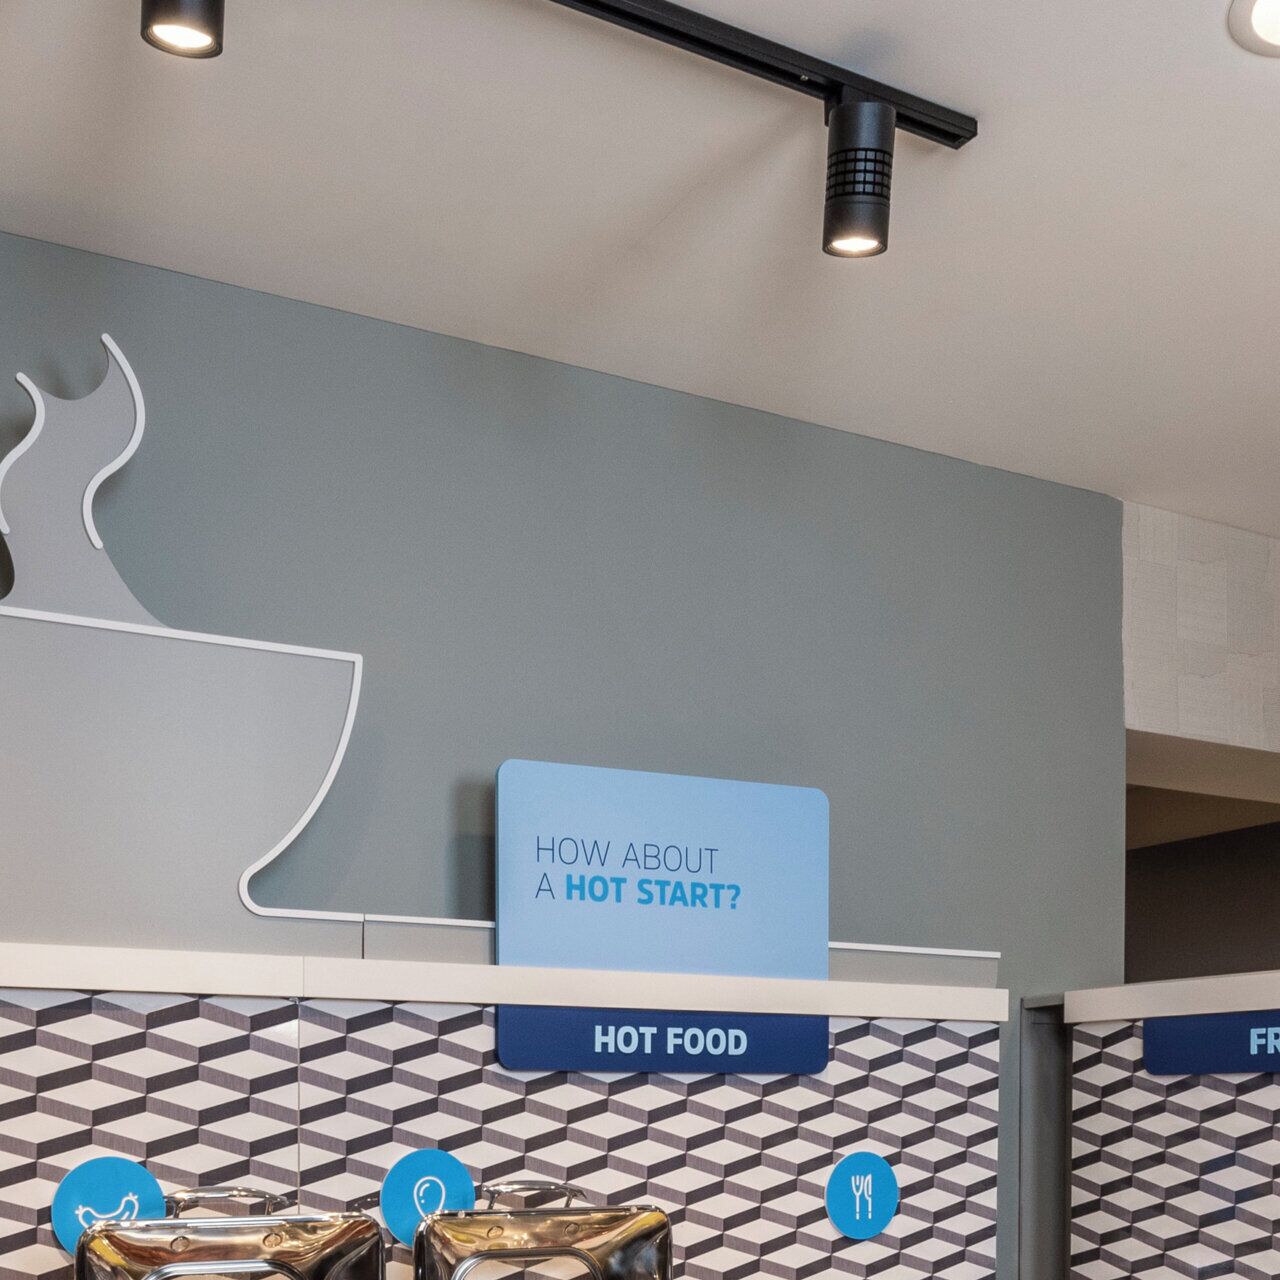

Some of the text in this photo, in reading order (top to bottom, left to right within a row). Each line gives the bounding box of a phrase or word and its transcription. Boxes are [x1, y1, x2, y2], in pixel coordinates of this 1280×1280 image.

[536, 834, 720, 875] HOW ABOUT
[535, 872, 742, 910] A HOT START?
[594, 1024, 748, 1056] HOT FOOD
